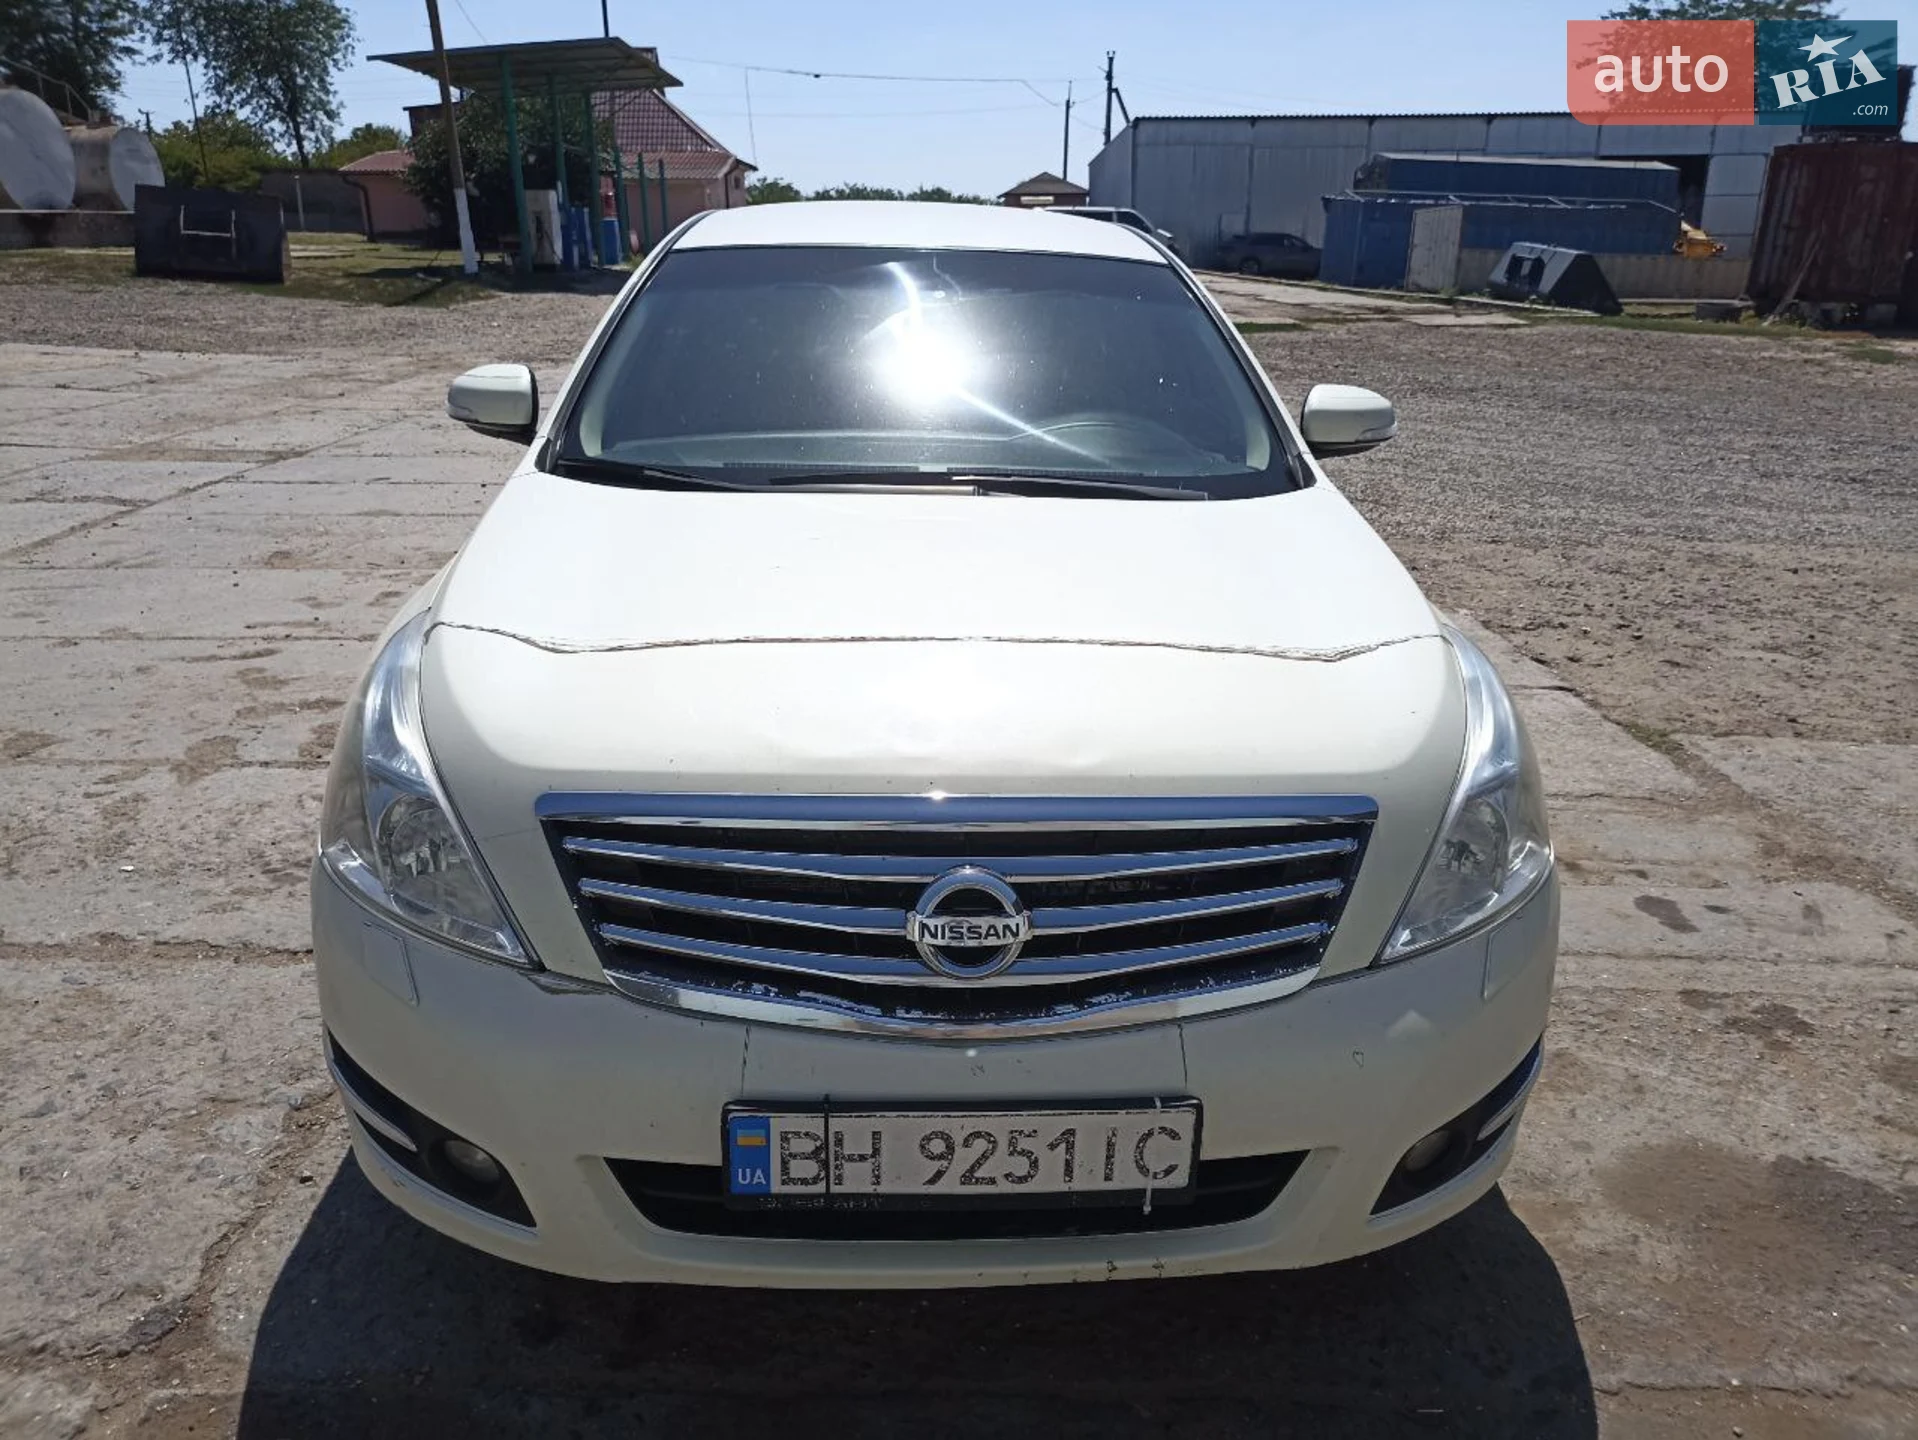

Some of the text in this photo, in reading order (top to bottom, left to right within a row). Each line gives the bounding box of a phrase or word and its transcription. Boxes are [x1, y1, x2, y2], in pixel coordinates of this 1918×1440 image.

[919, 921, 1020, 941] NISSAN
[780, 1125, 1182, 1187] BH 9251 IC
[737, 1168, 767, 1185] UA
